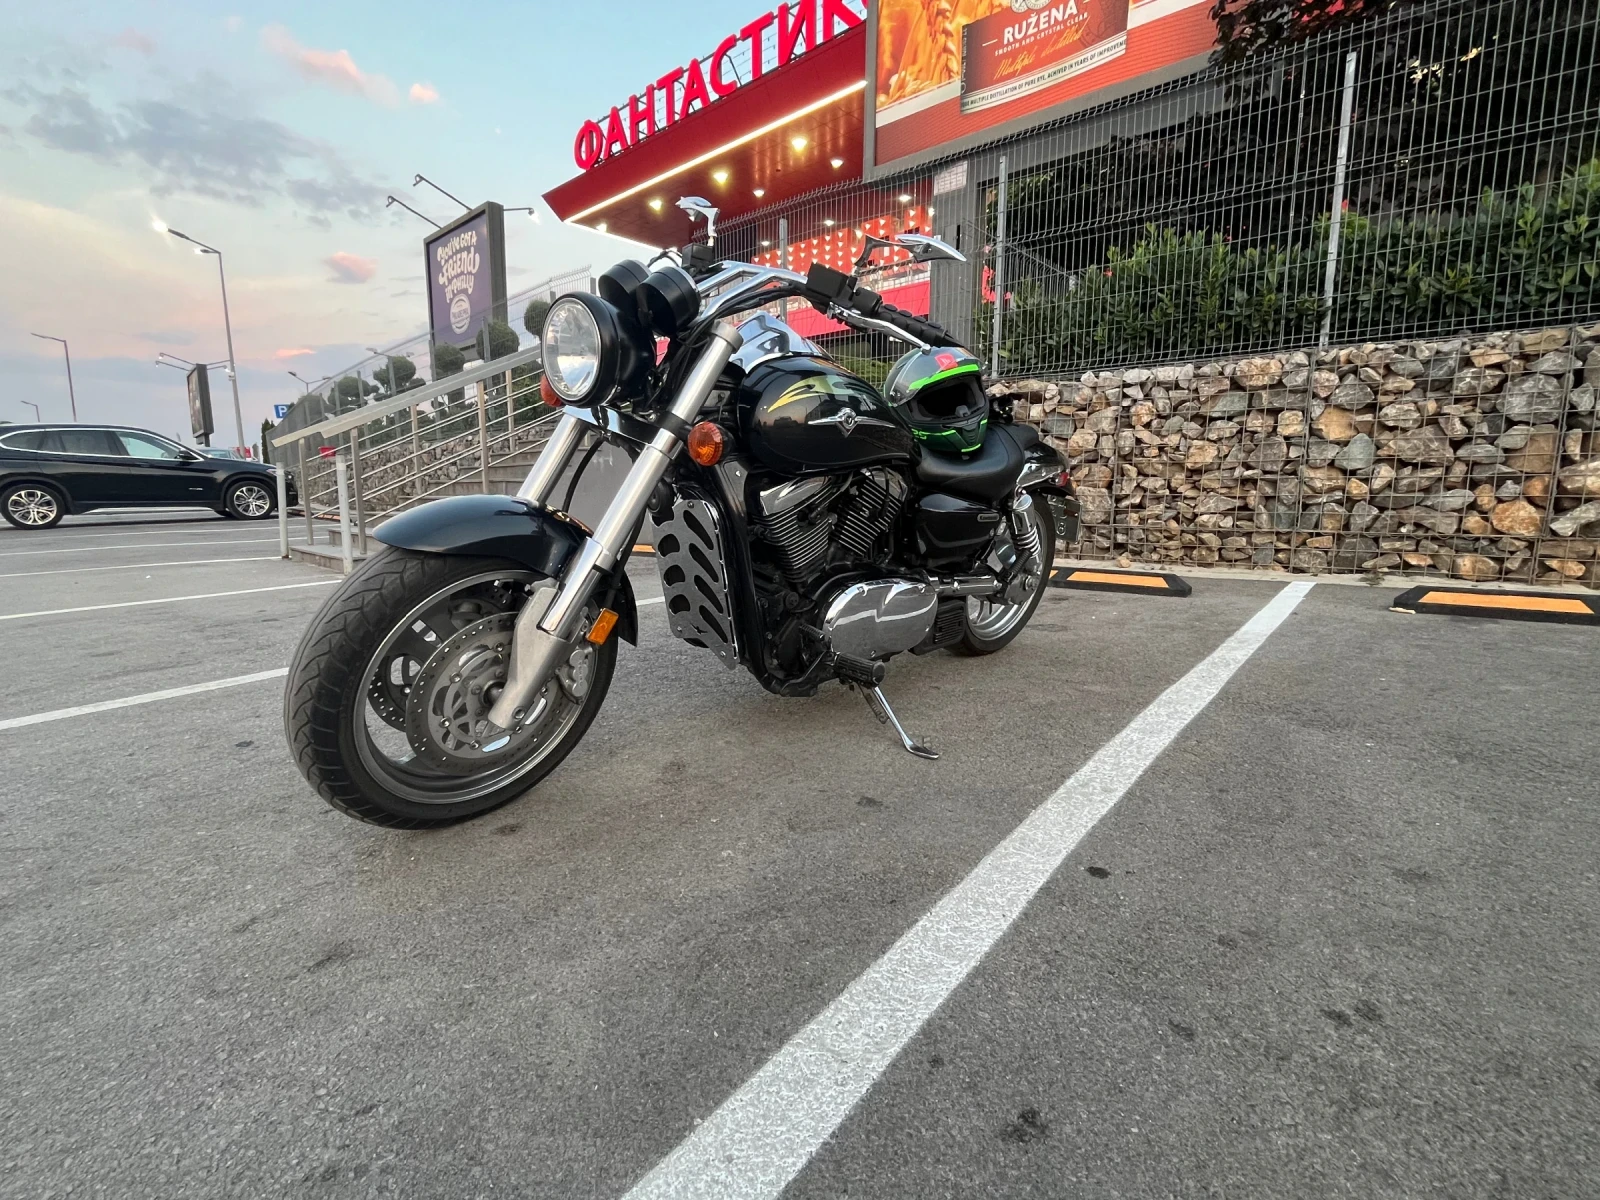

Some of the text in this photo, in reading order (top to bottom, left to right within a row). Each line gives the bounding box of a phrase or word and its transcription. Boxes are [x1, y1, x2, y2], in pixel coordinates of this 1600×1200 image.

[995, 12, 1088, 57] SMOOTH AND CRYSTAL CLEAR
[1003, 0, 1078, 45] RUŽENA
[574, 0, 867, 170] ФАНТАСТИК
[970, 94, 989, 105] MULTIPLE
[990, 85, 1018, 100] DISTILLATION
[1018, 82, 1024, 90] OF
[1024, 78, 1036, 88] PURE
[1074, 56, 1090, 69] YEARS
[1089, 52, 1096, 61] OF
[278, 406, 287, 417] P
